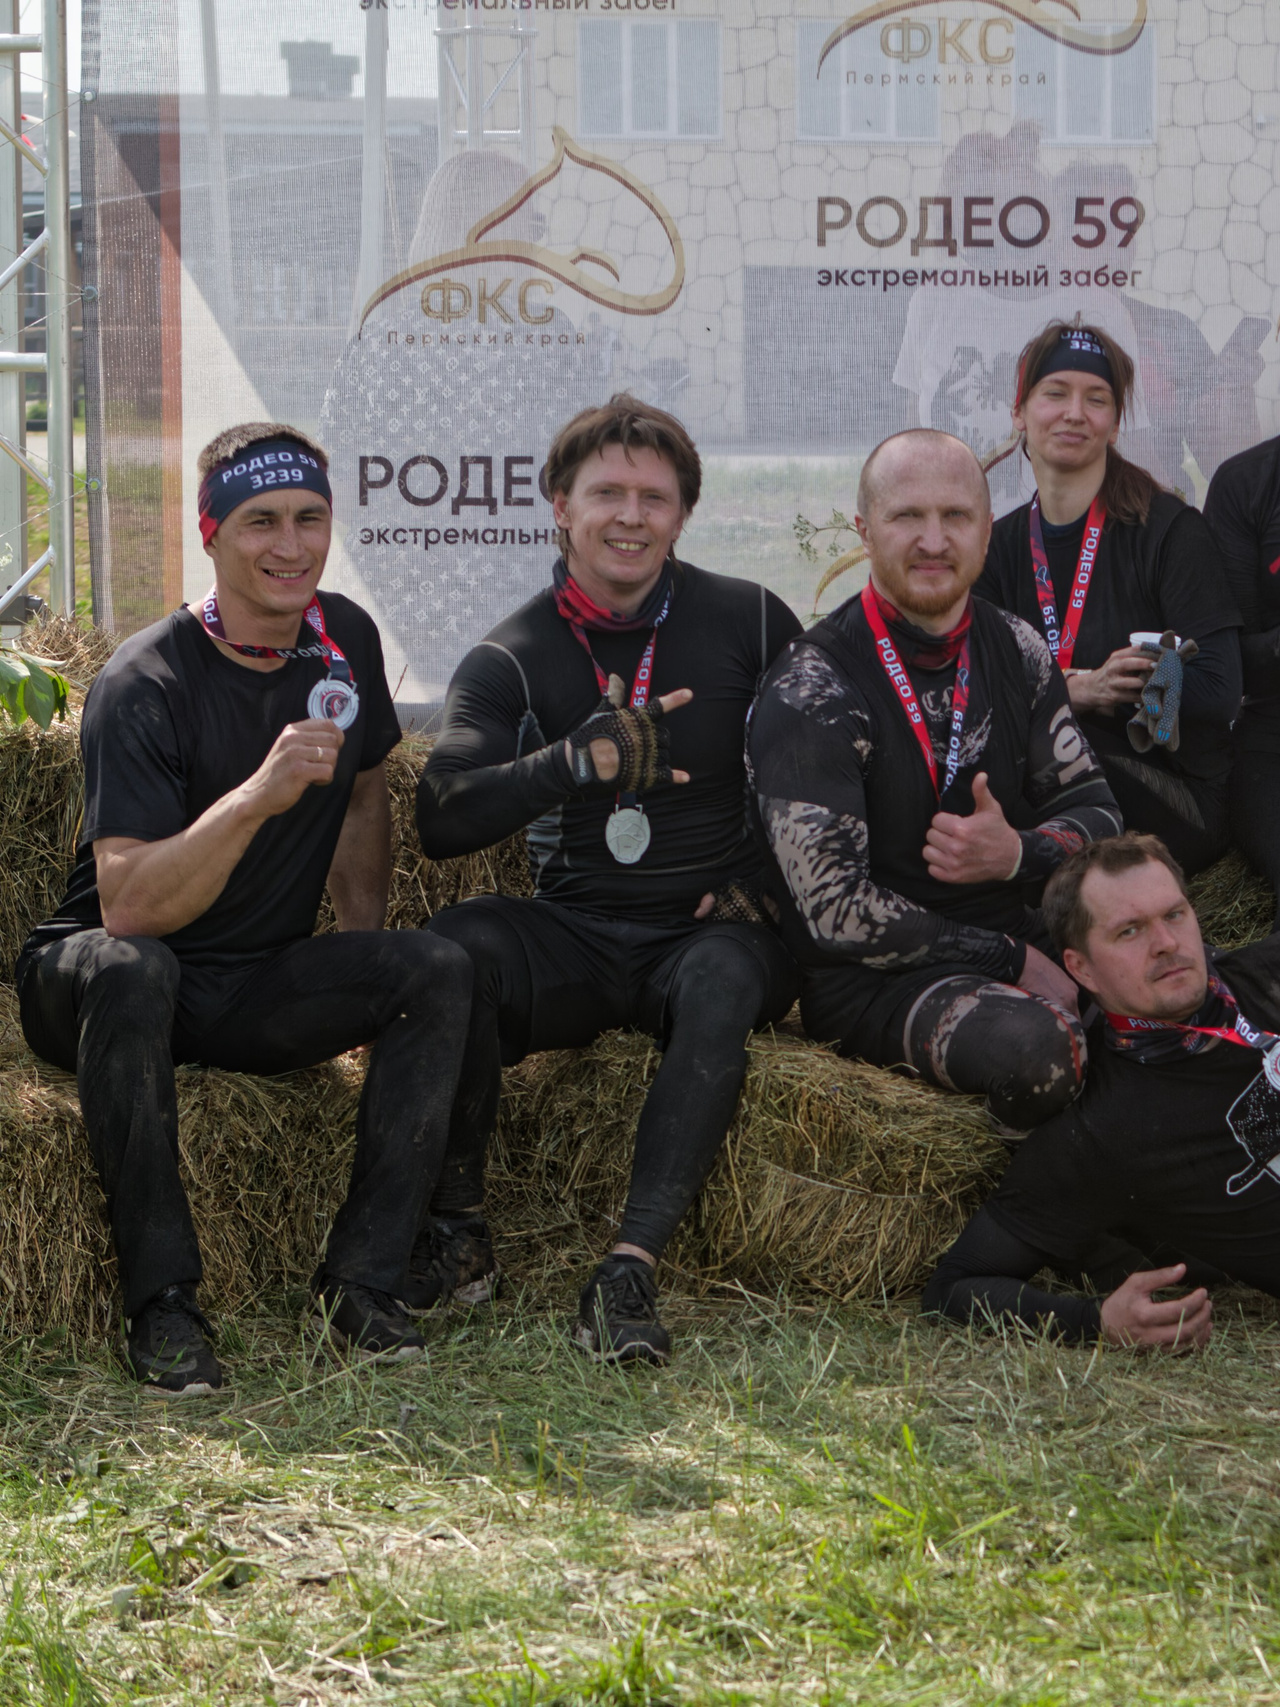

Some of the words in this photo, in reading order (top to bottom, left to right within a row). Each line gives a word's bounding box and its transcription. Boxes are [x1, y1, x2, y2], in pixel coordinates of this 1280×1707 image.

[880, 17, 1015, 65] ФКС
[846, 70, 972, 87] Пермский
[986, 70, 1047, 87] край
[817, 196, 1050, 257] РОДЕО
[1071, 196, 1146, 248] 59
[817, 265, 1049, 292] экстремальный
[1059, 265, 1142, 287] забег
[420, 278, 555, 325] ФКС
[387, 331, 514, 347] Пермский
[526, 331, 586, 347] край
[1069, 340, 1107, 357] 323
[222, 452, 293, 484] РОДЕО
[298, 453, 318, 469] 59
[250, 468, 304, 489] 3239
[359, 527, 560, 550] экстремальн
[1077, 527, 1100, 585] РОДЕО
[1072, 589, 1086, 608] 59
[1043, 605, 1056, 625] 59
[877, 637, 912, 698] РОДЕО
[906, 702, 922, 724] 59
[633, 686, 647, 708] 59
[952, 710, 964, 732] 59
